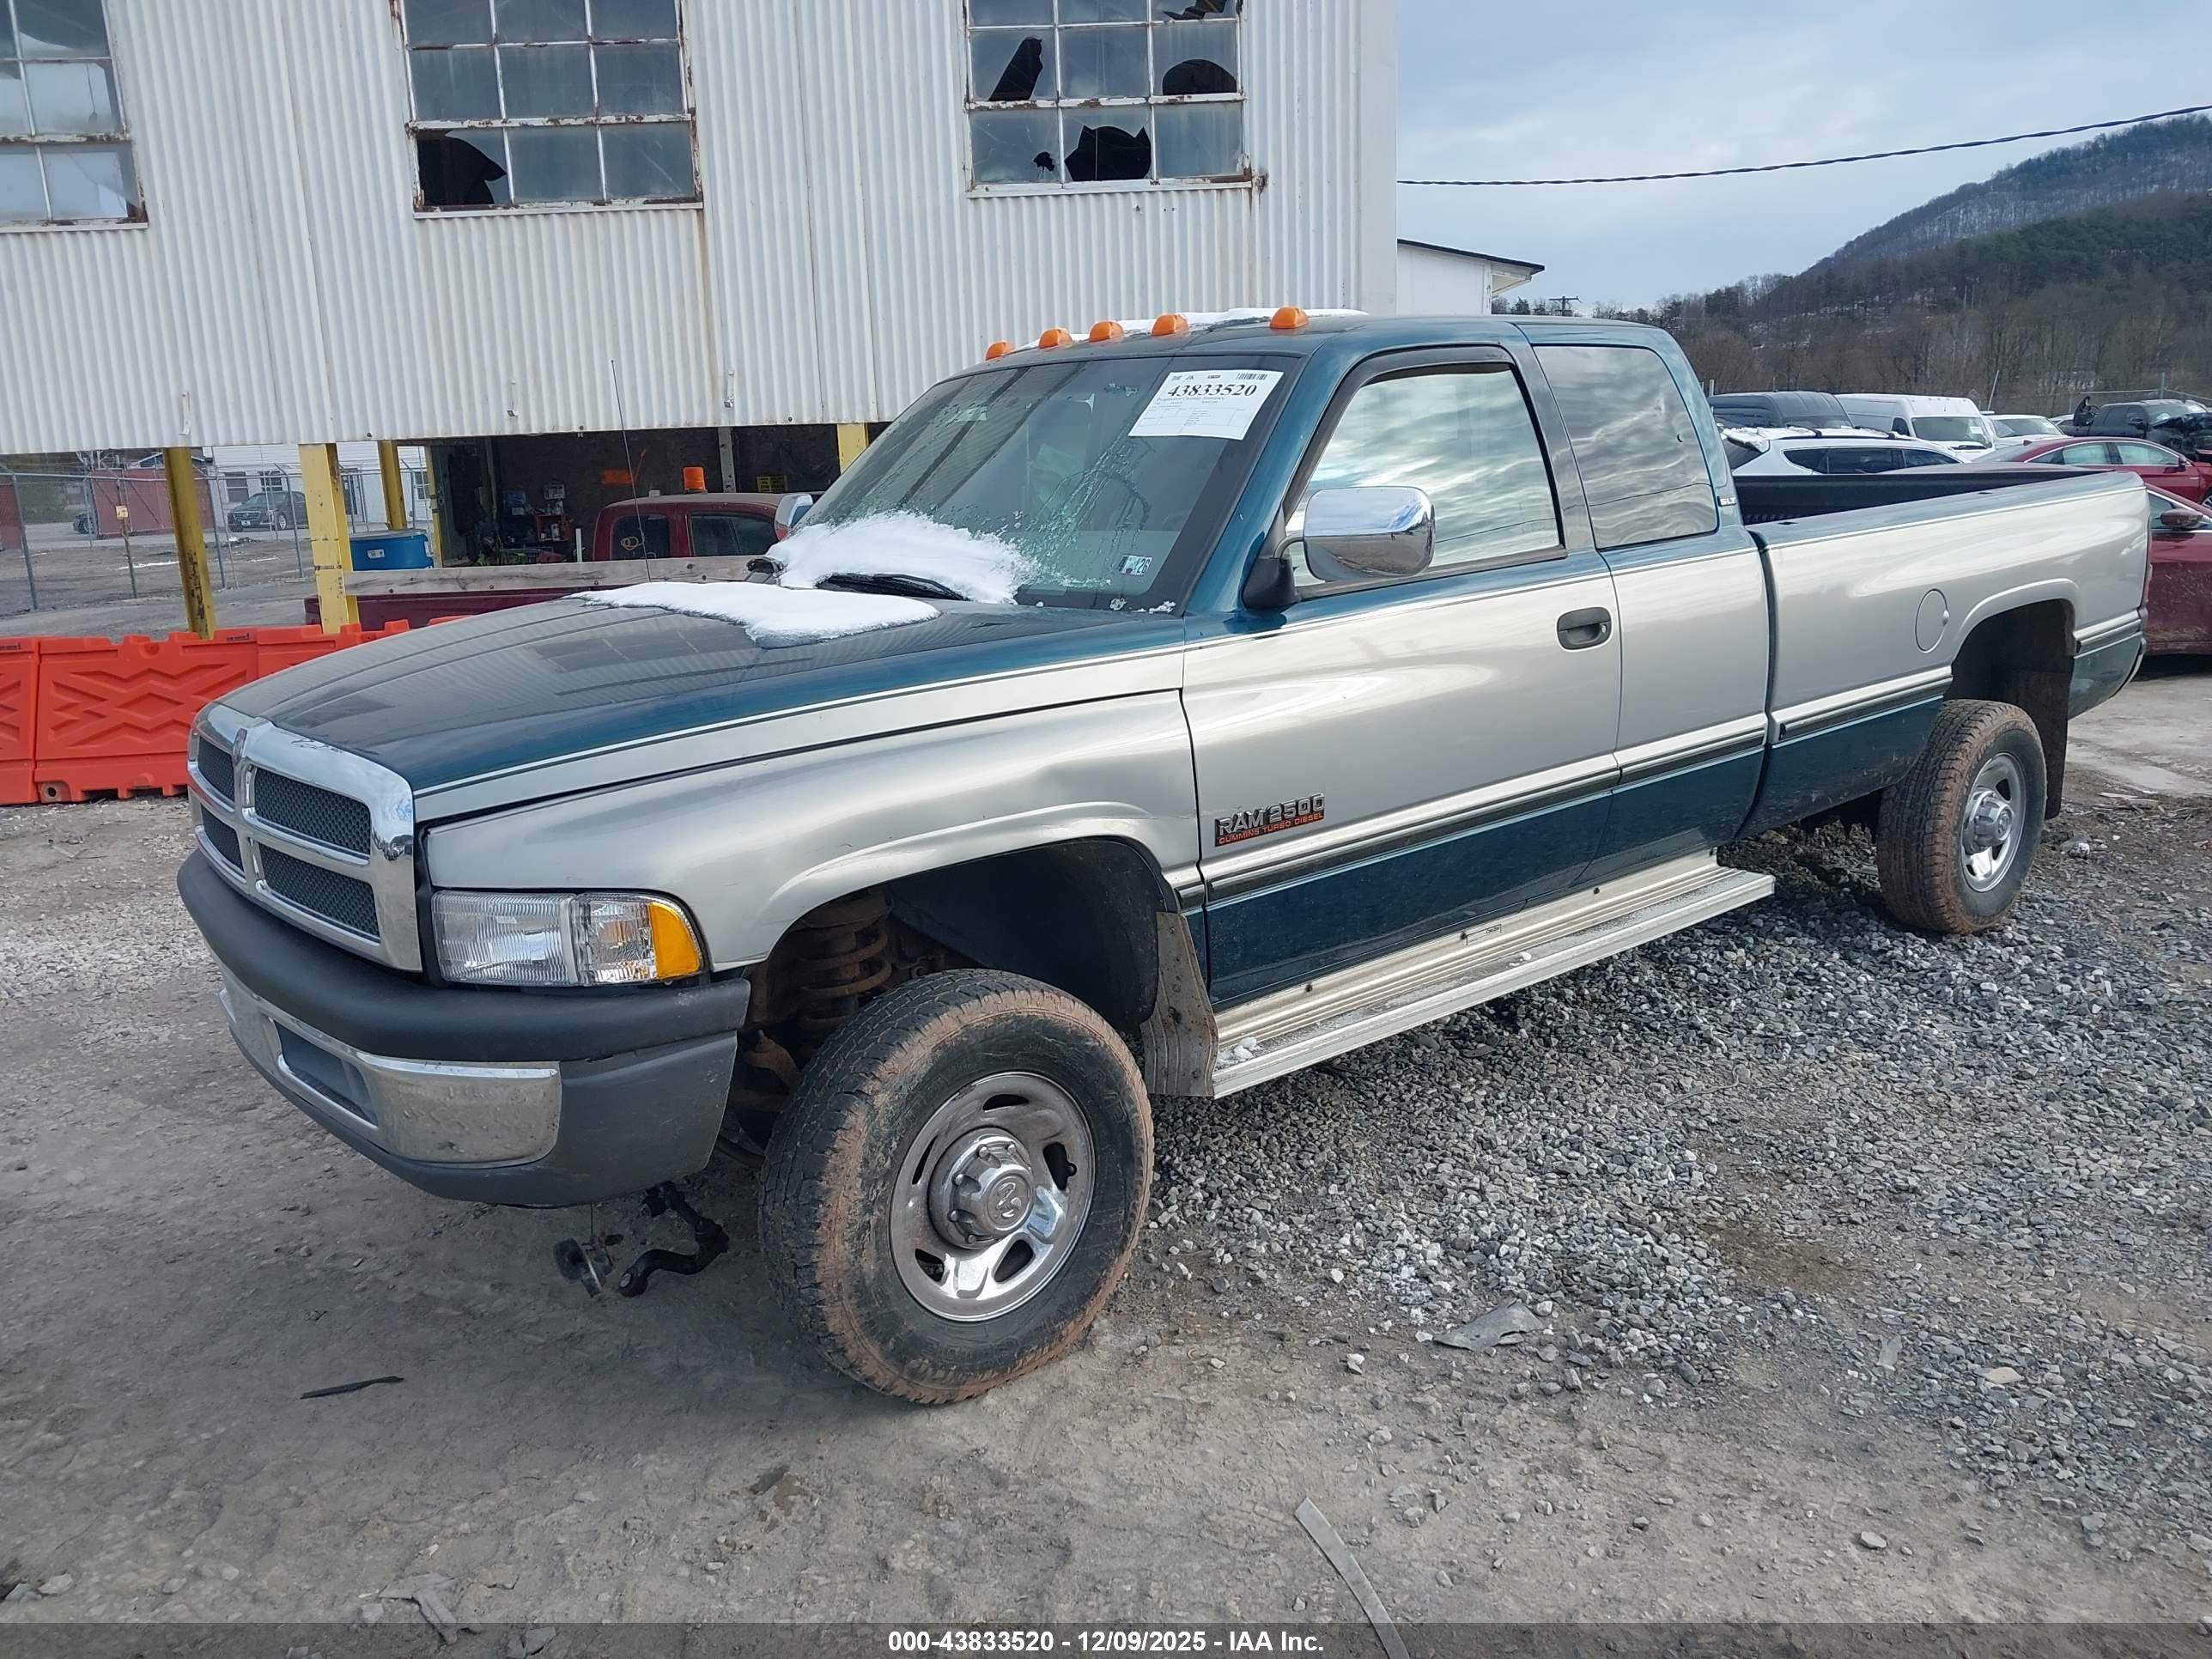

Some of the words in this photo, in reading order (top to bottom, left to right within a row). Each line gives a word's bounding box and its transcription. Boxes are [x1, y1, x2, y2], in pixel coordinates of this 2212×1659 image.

[1168, 384, 1257, 397] 43833520
[1218, 809, 1265, 836] RAM
[1269, 793, 1324, 823] 2500
[1218, 829, 1260, 845] CUMMINS
[1263, 820, 1291, 833] TURBO
[1294, 811, 1324, 824] DIESEL
